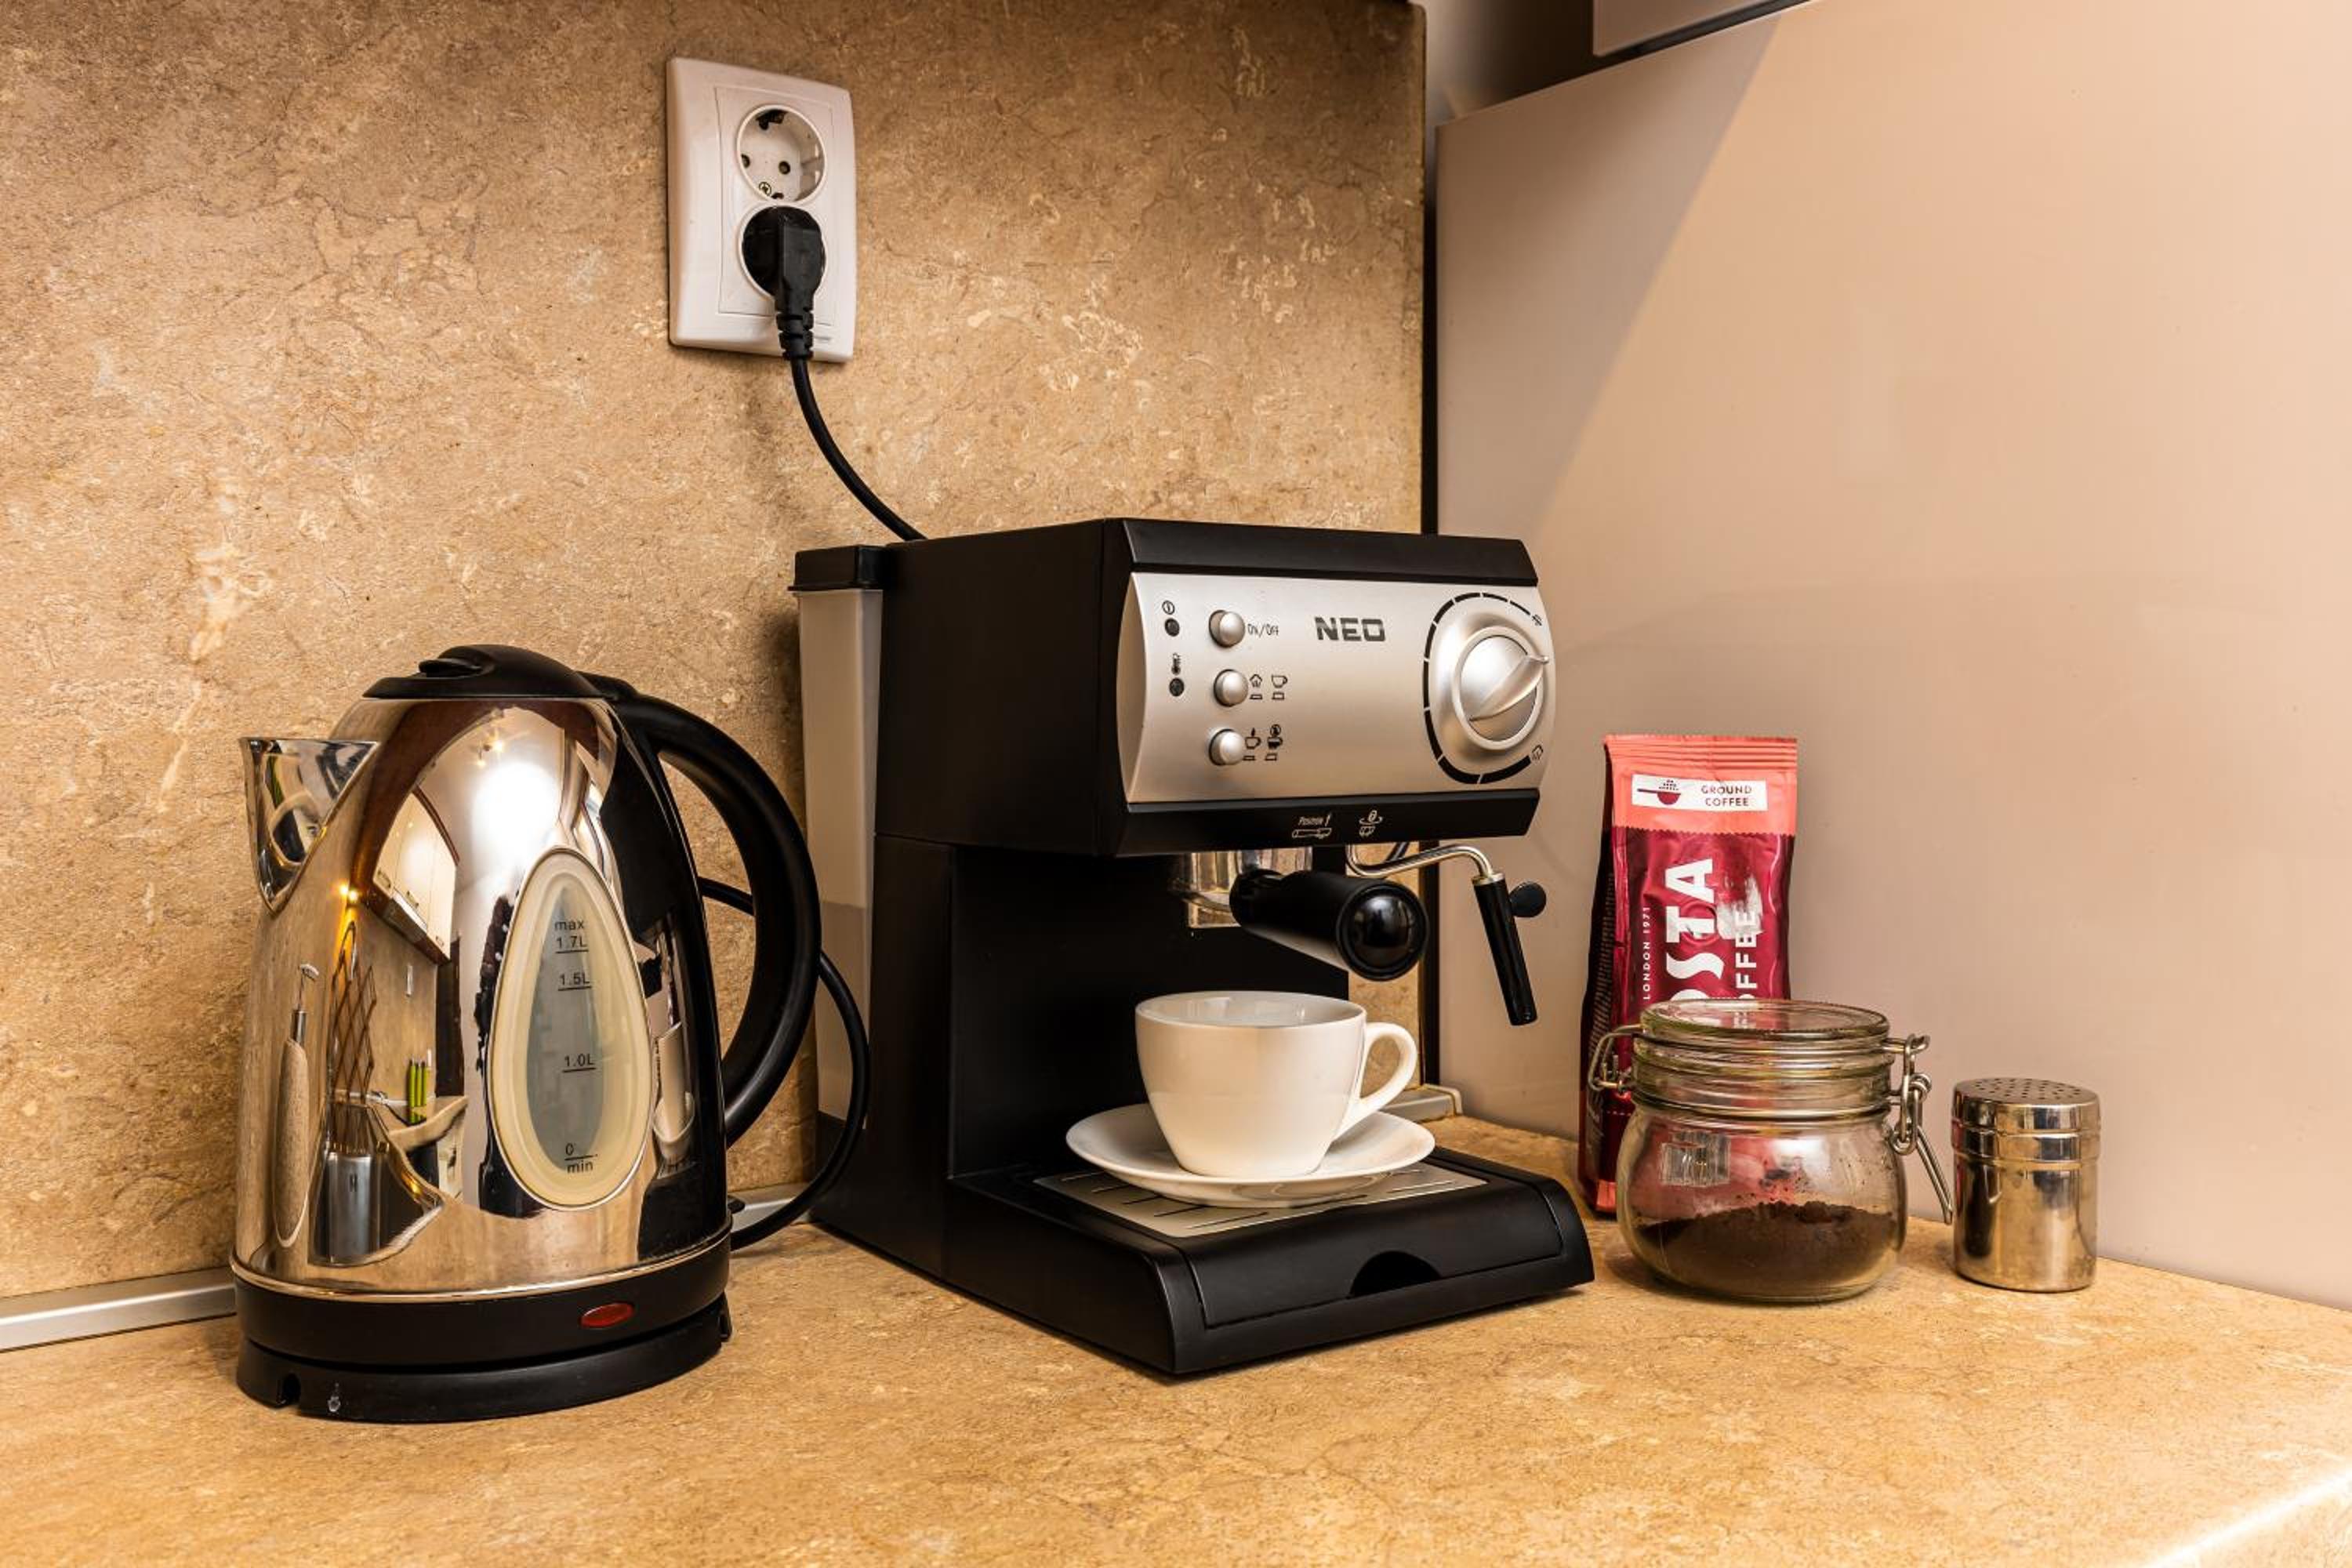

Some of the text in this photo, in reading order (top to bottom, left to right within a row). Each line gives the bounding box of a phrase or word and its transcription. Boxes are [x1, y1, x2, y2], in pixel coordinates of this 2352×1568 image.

[1314, 616, 1385, 642] NEO
[1700, 785, 1752, 795] GROUND
[1704, 797, 1749, 807] COFFEE
[554, 920, 584, 931] max
[1642, 907, 1651, 1000] LONDON 1971
[1735, 911, 1758, 999] FFEE
[559, 972, 590, 985] 1.5L
[564, 1053, 595, 1067] 1.0L
[564, 1142, 575, 1156] 0
[567, 1160, 593, 1174] min
